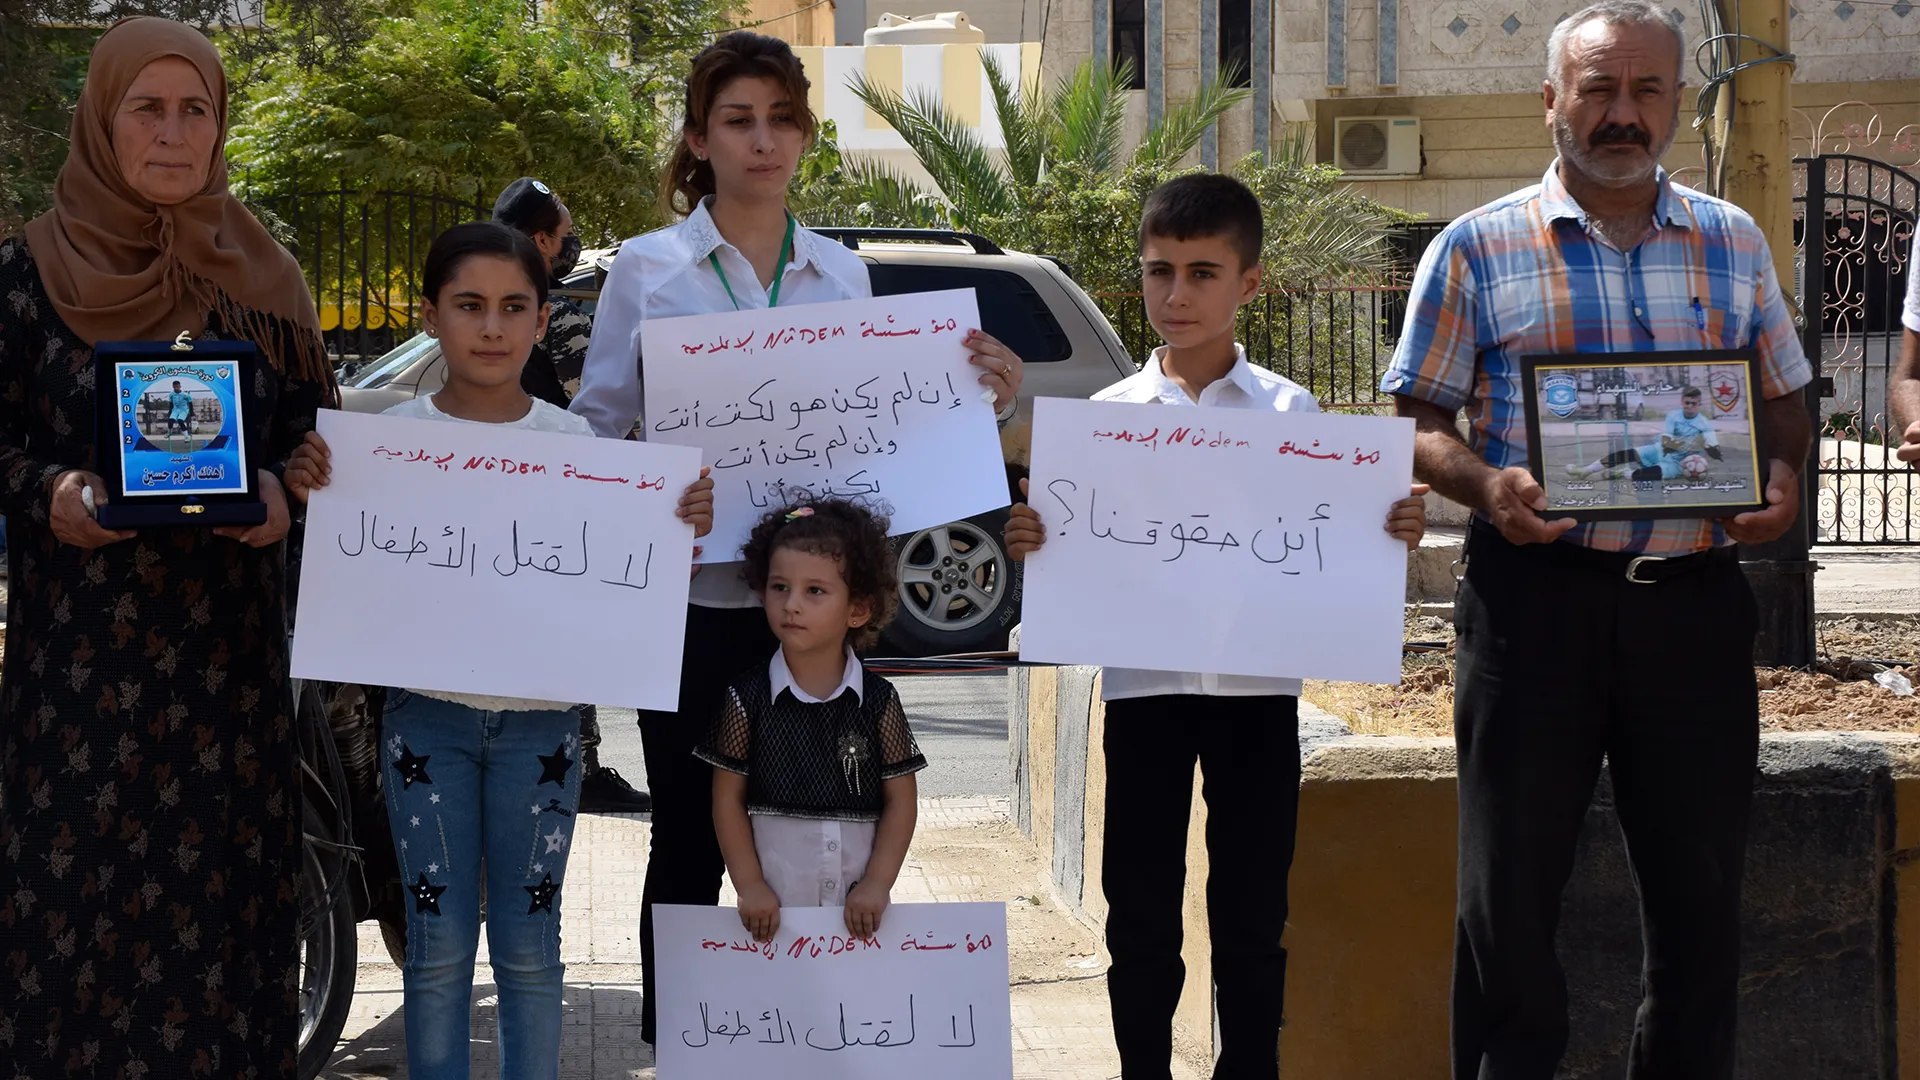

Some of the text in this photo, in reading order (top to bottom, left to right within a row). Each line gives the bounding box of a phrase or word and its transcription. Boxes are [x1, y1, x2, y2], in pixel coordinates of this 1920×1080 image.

[832, 376, 880, 418] يكن
[892, 371, 913, 425] لم
[918, 371, 962, 410] إن
[654, 399, 700, 432] أنت
[786, 398, 827, 431] هو
[714, 439, 770, 468] أنت
[775, 433, 819, 467] يكن
[825, 425, 848, 469] لم
[142, 468, 170, 486] حسين
[173, 464, 196, 484] أكرم
[338, 510, 653, 589] لا لقتل الأطفال
[1251, 503, 1331, 575] أين
[542, 799, 572, 817] Jeans
[682, 994, 976, 1051] لا لقتل الأطفال
